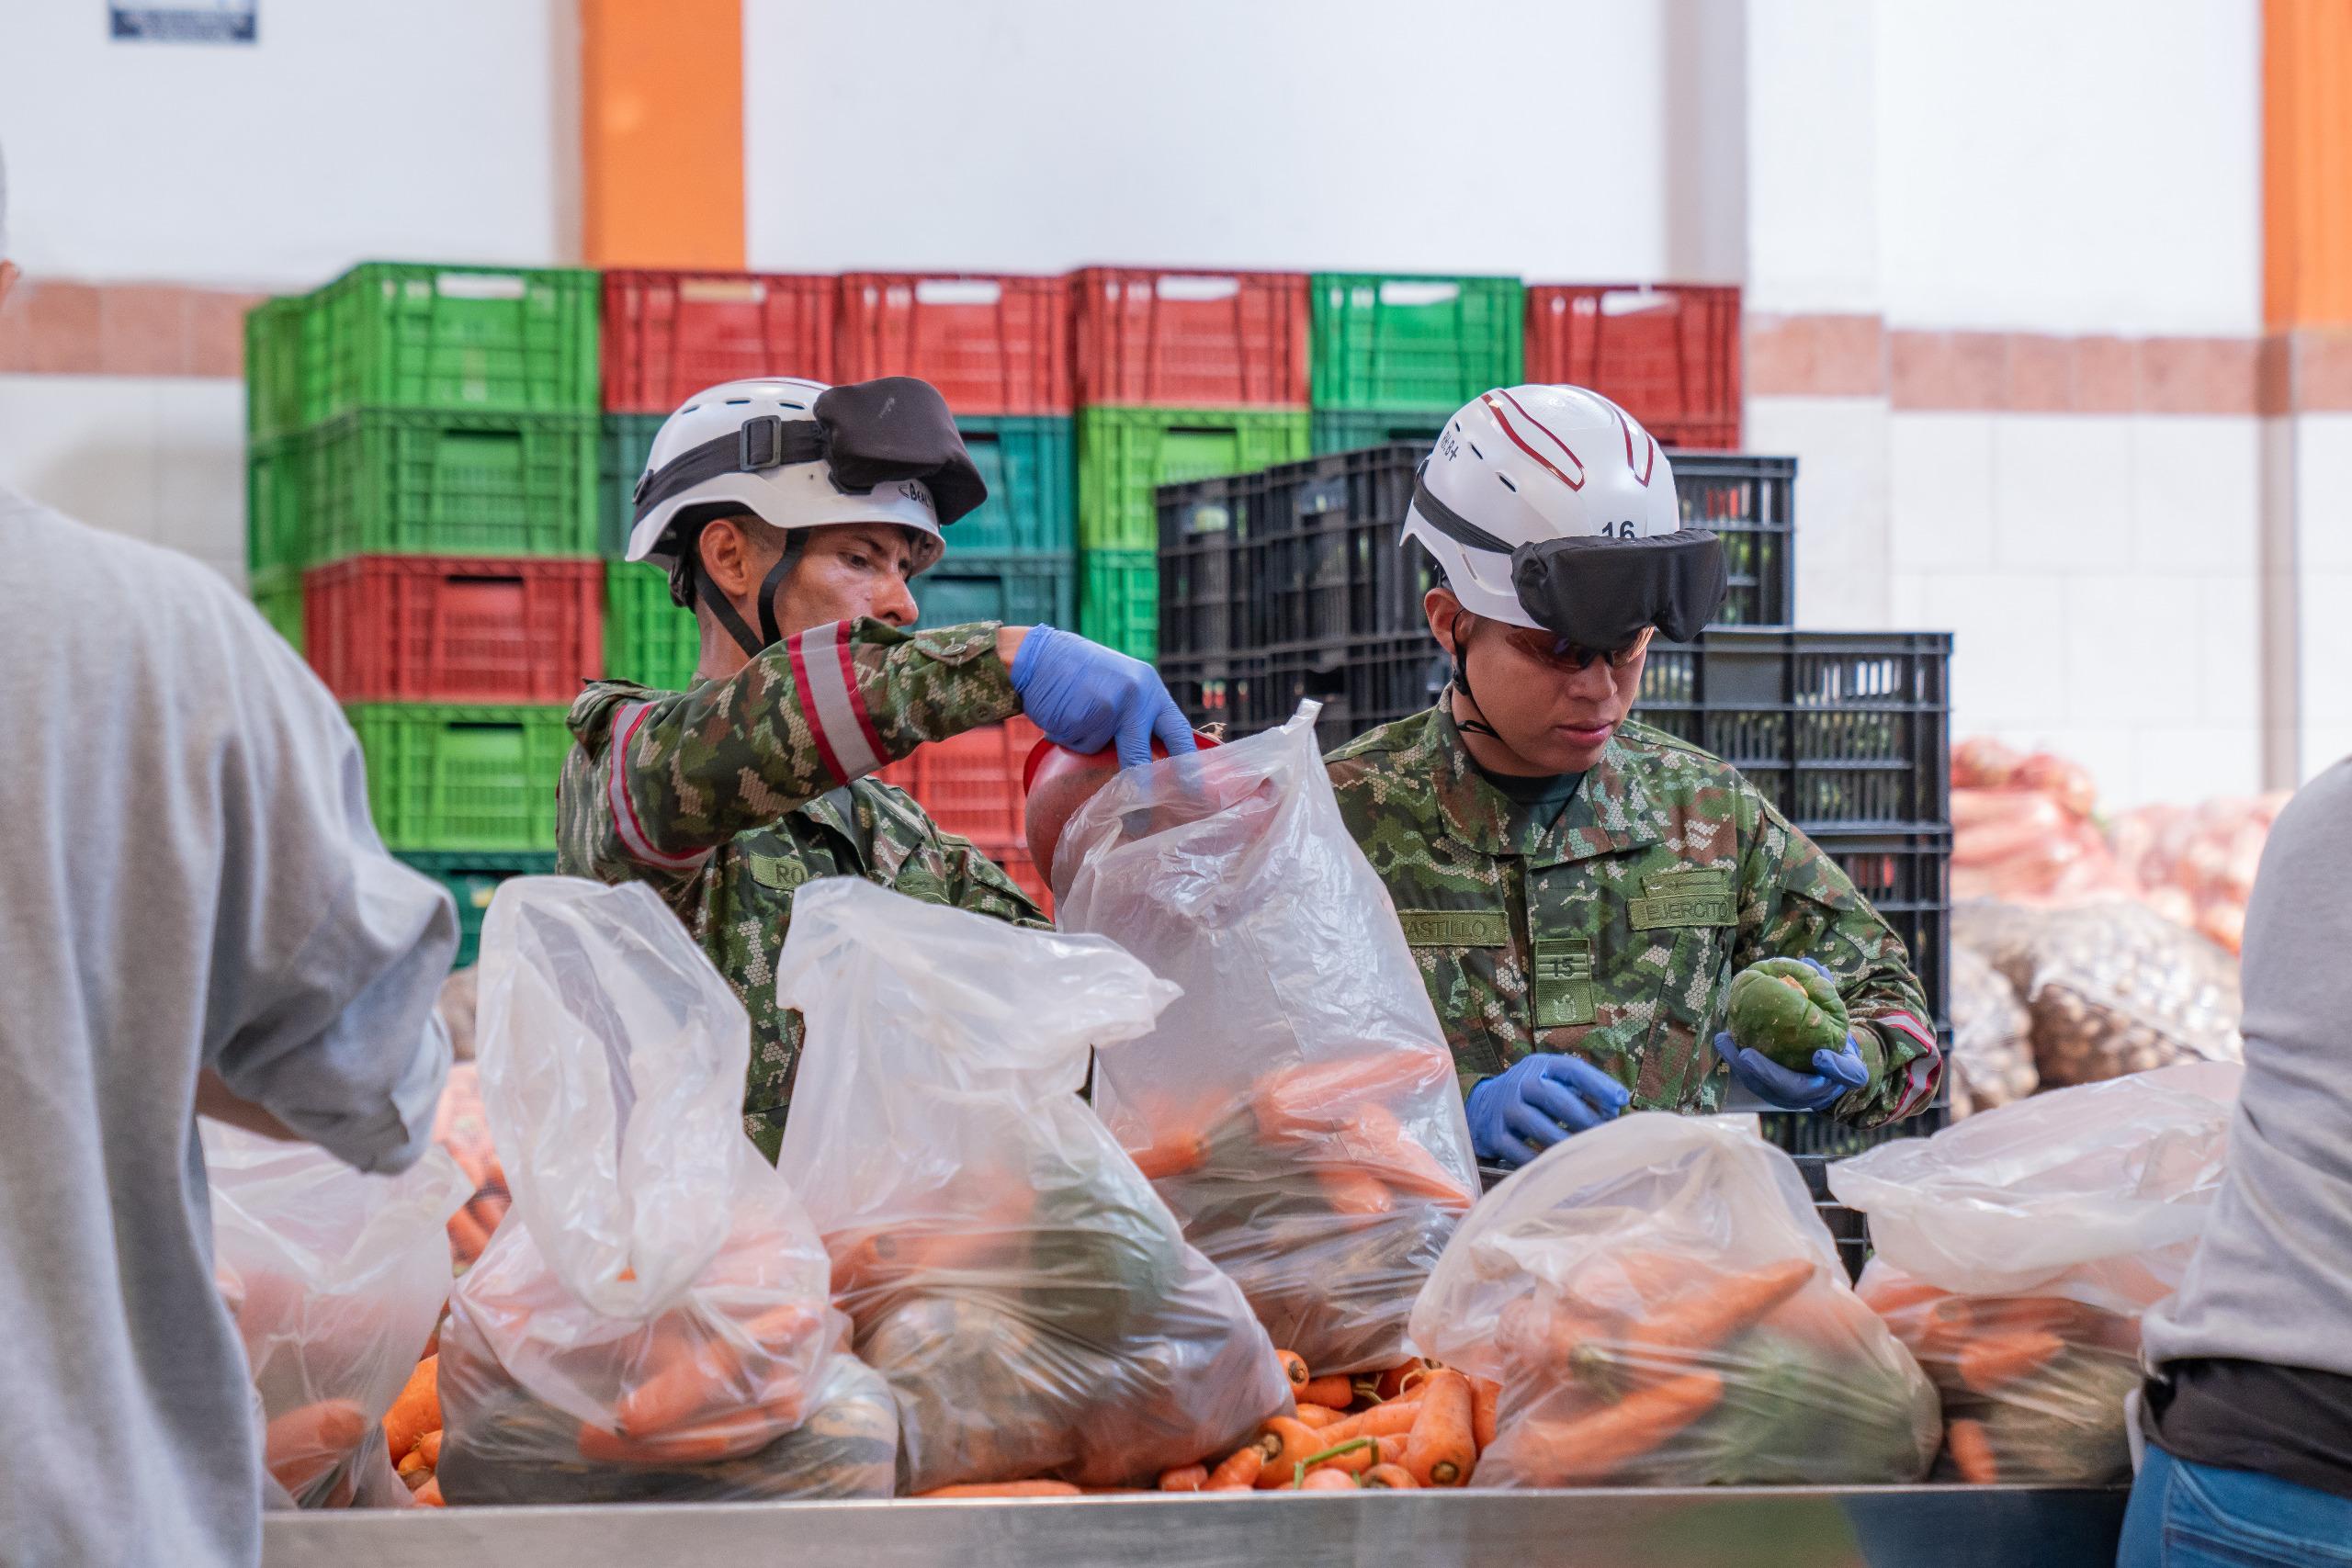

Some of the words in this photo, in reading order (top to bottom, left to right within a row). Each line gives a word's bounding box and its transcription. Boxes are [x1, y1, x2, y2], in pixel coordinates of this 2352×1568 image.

[1602, 520, 1635, 539] 16
[1645, 901, 1728, 920] EJERCITO
[1403, 919, 1487, 938] ASTILLO
